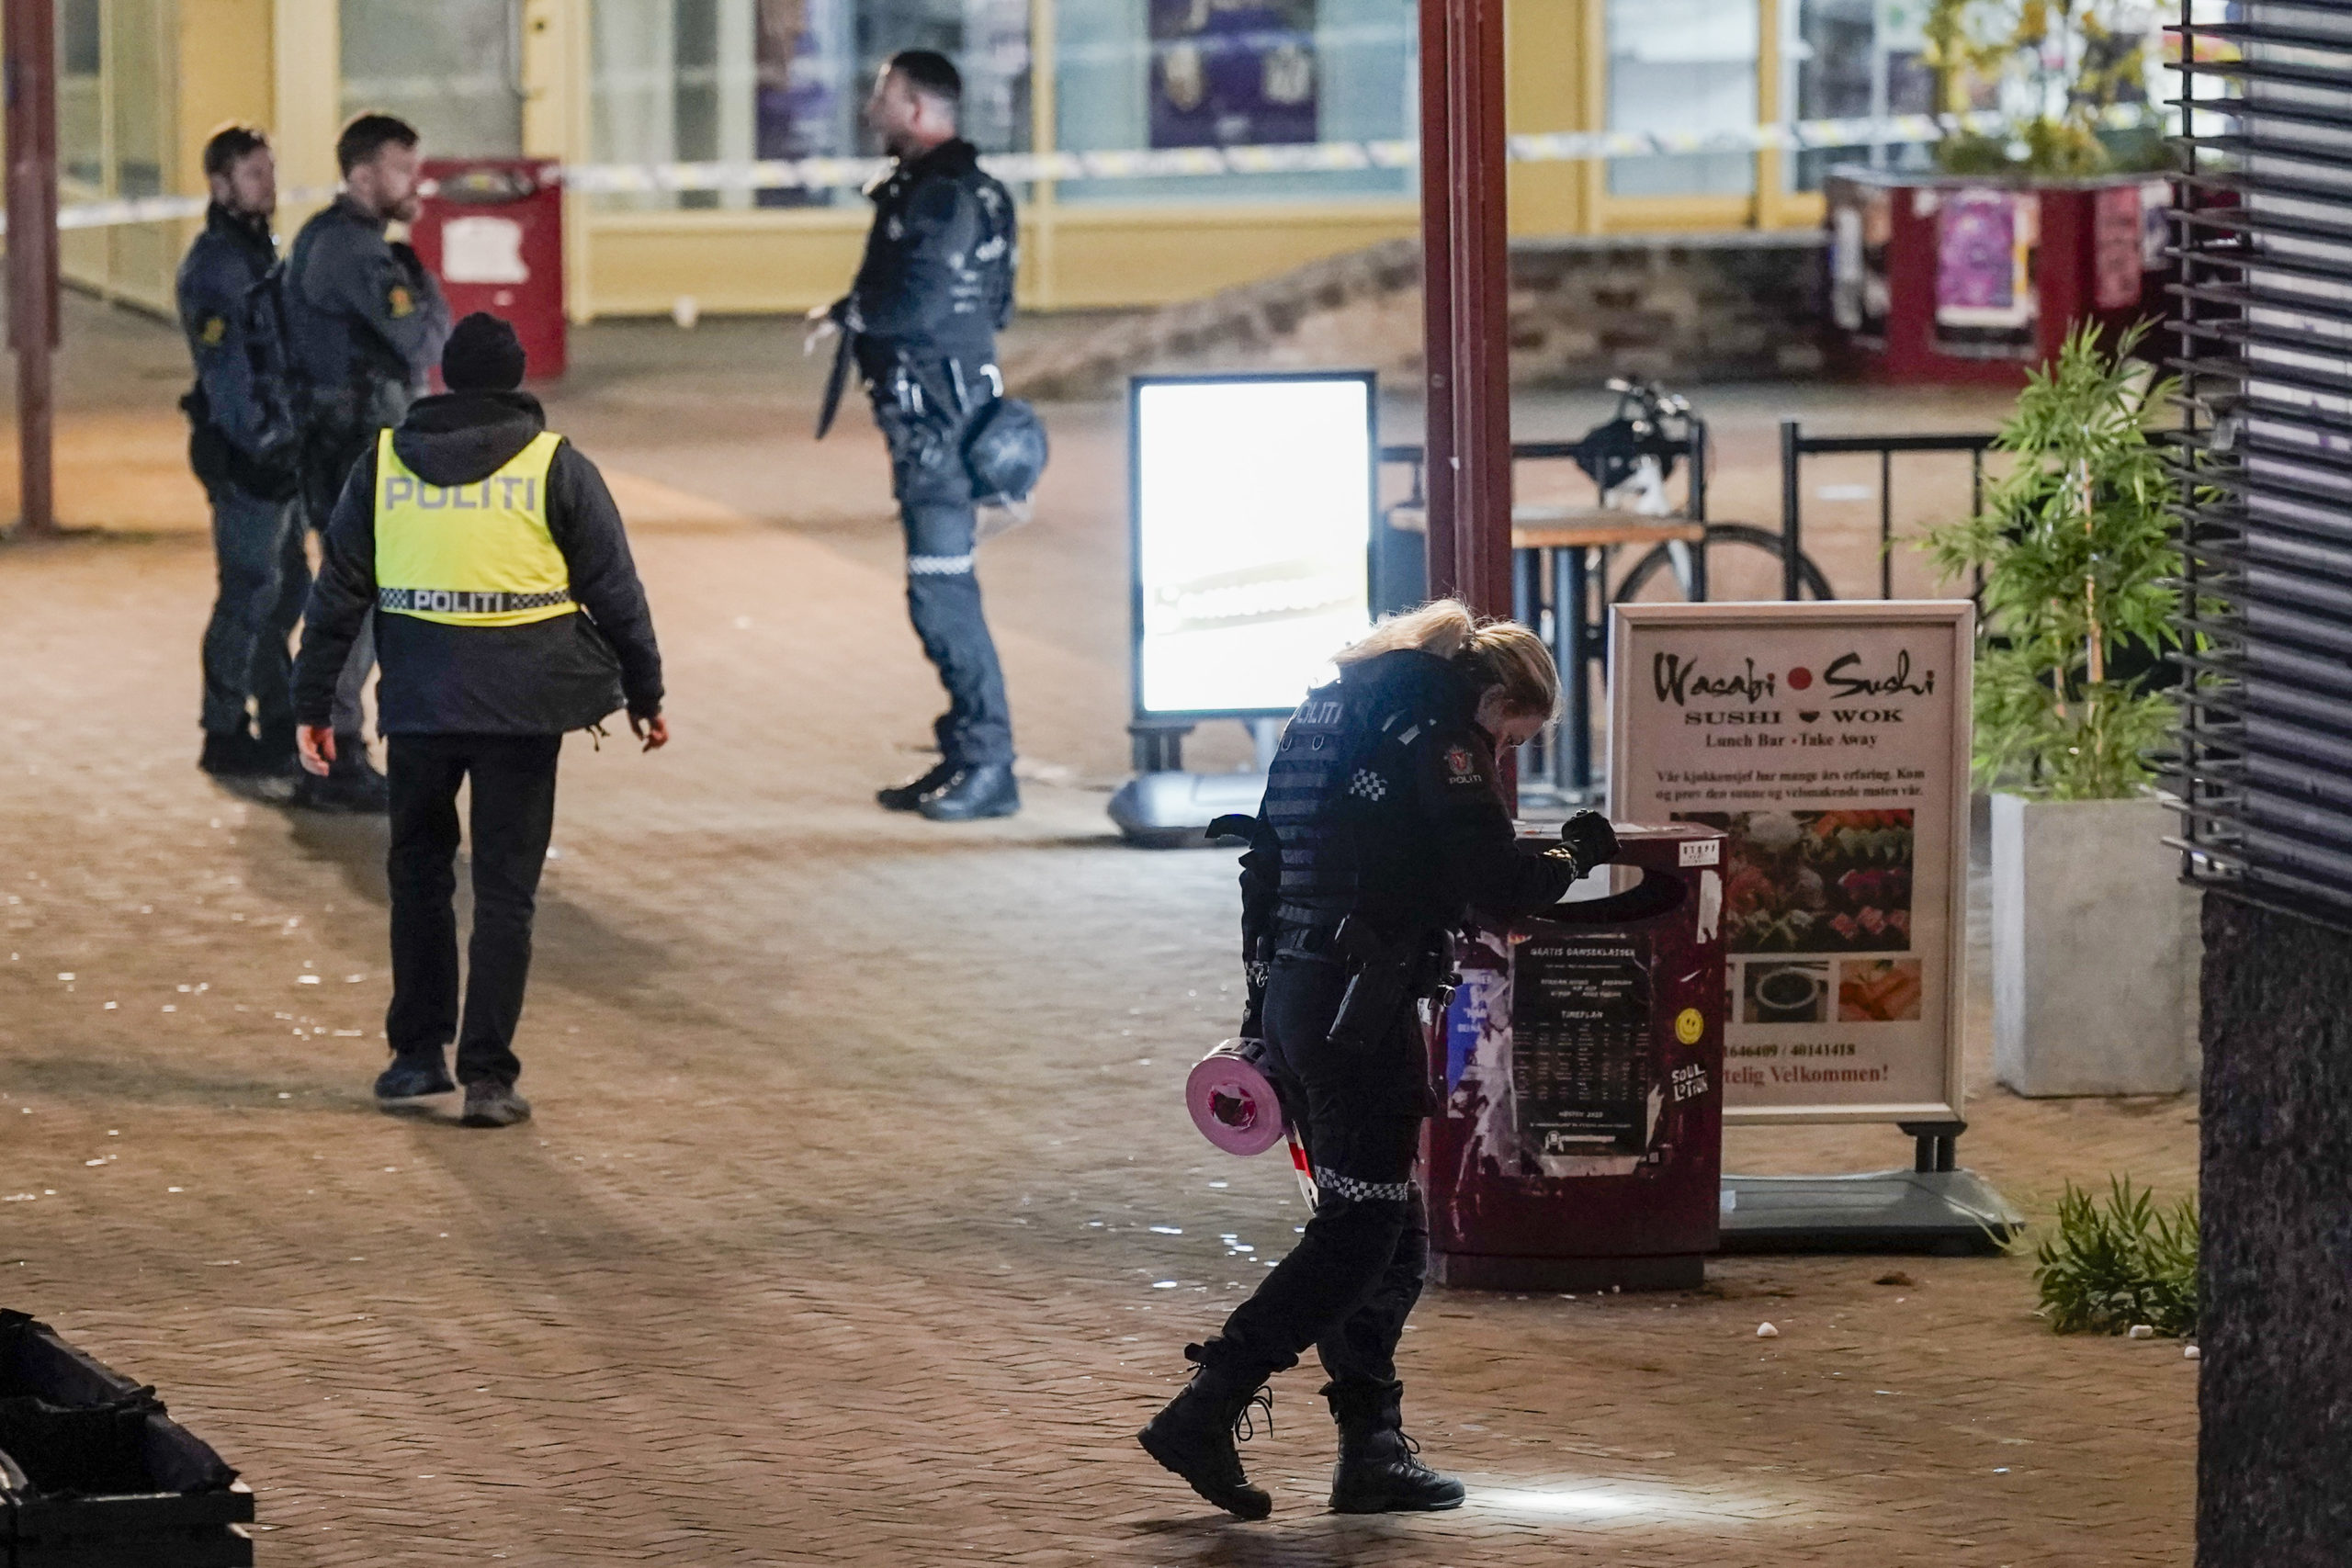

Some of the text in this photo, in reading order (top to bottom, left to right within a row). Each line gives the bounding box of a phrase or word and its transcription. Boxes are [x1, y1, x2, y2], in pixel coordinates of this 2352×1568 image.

[385, 477, 536, 511] POLITI
[414, 589, 503, 613] POLITI
[1653, 649, 1935, 706] Wasabi Sushi
[1295, 701, 1344, 724] OLITI
[1684, 708, 1905, 726] SUSHI WOK
[1705, 733, 1878, 749] Lunch Bar Take Away
[1449, 774, 1482, 784] POLITI
[1671, 1064, 1706, 1084] SOUL
[1770, 1064, 1889, 1083] Velkommen!
